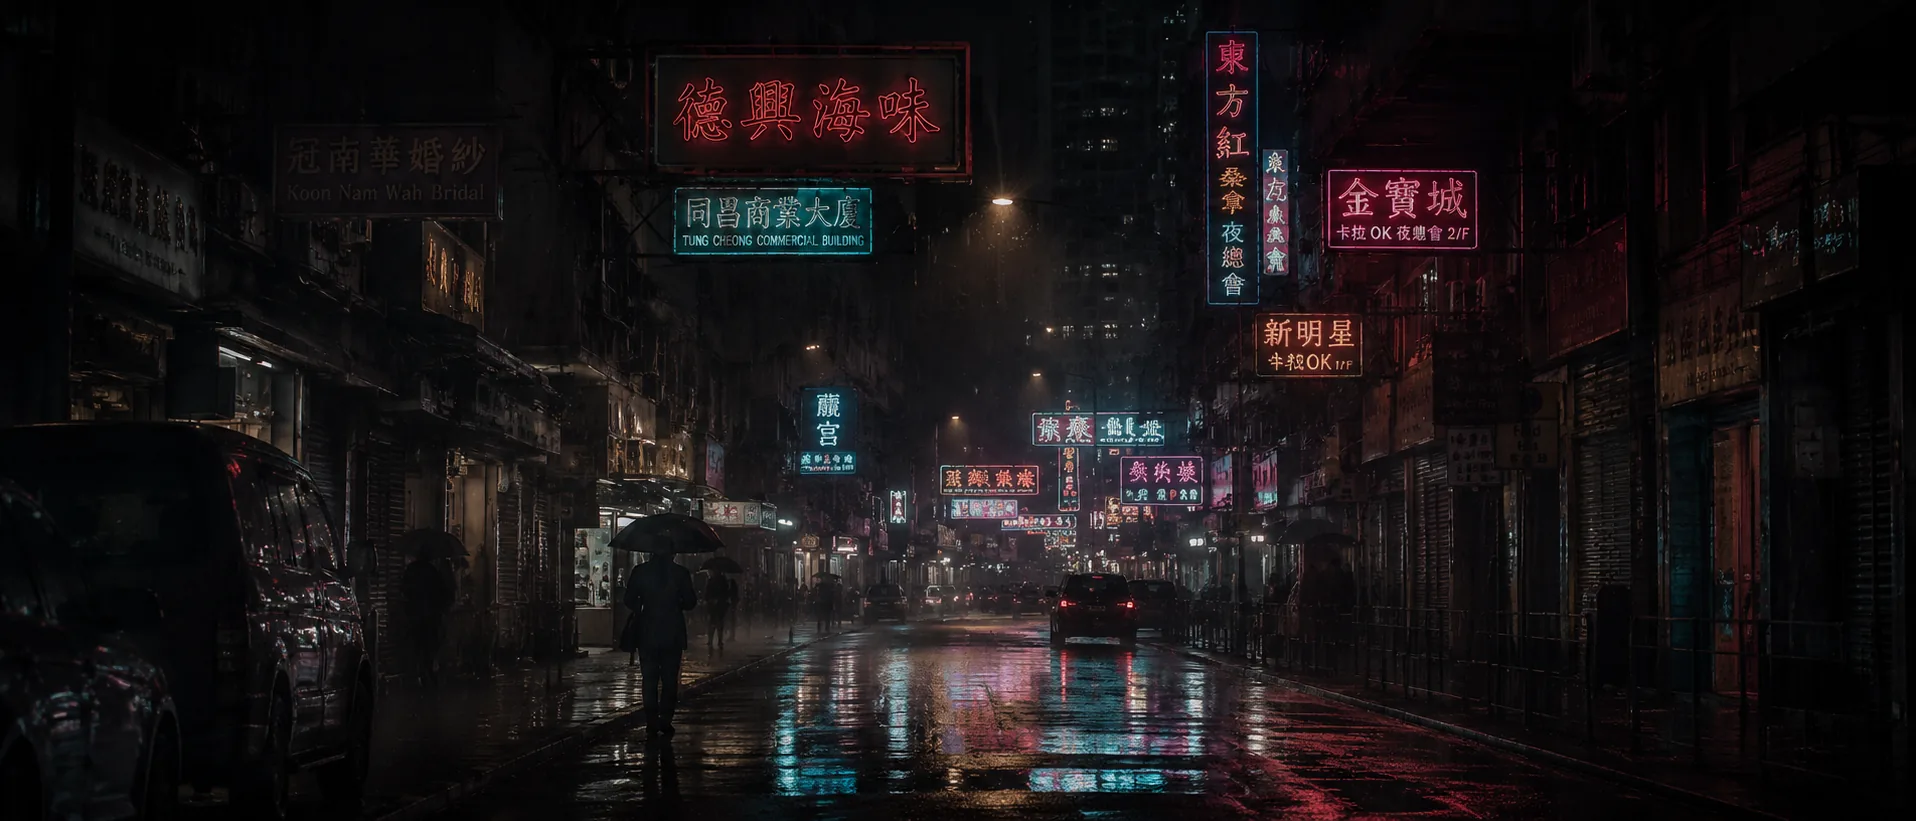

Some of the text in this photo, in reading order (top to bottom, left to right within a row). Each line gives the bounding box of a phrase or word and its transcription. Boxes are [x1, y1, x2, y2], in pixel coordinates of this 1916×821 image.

[673, 77, 941, 143] 德興海味
[286, 135, 487, 176] 冠南華婚紗
[286, 183, 485, 200] Koon Nam Wah Bridal
[1338, 177, 1468, 220] 金寶城
[686, 195, 861, 230] 同昌商業大廈
[682, 234, 865, 247] TUNG CHEONG COMMERCIAL BUILDING
[1370, 226, 1393, 240] OK
[1447, 227, 1470, 240] 2/F
[1263, 318, 1355, 348] 新明星
